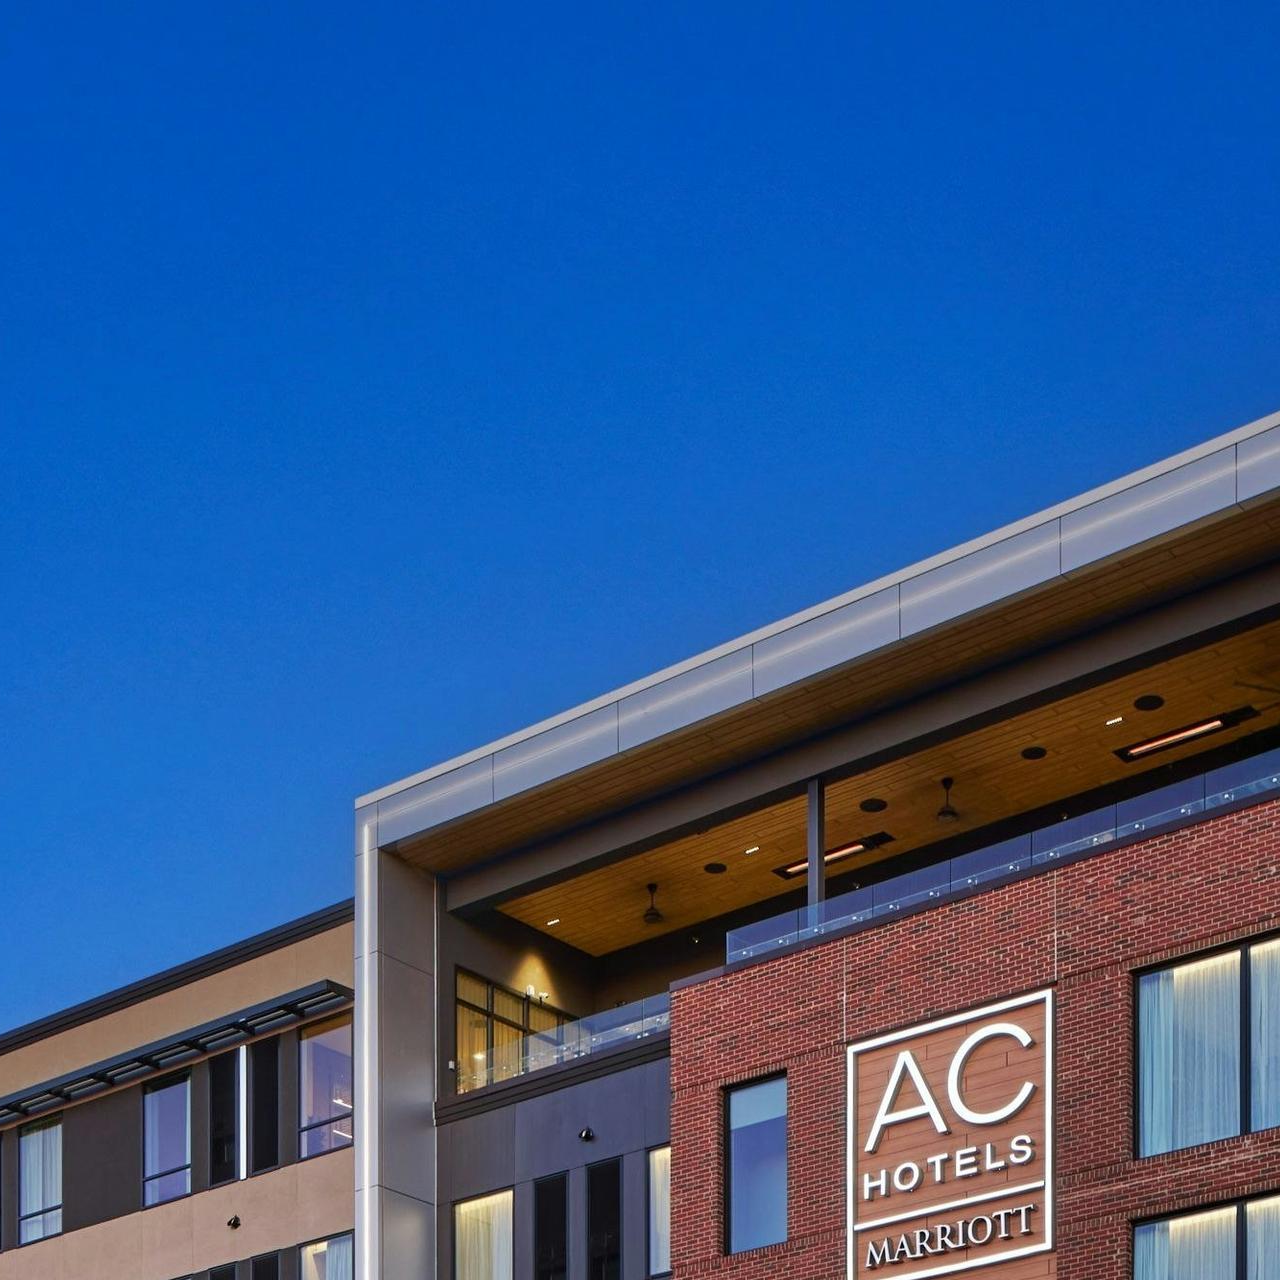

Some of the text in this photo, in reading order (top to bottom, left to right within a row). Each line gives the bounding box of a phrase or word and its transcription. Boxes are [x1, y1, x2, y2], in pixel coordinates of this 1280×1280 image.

[864, 1022, 1036, 1152] AC
[863, 1134, 1034, 1200] HOTELS
[865, 1203, 1035, 1269] MARRIOTT
